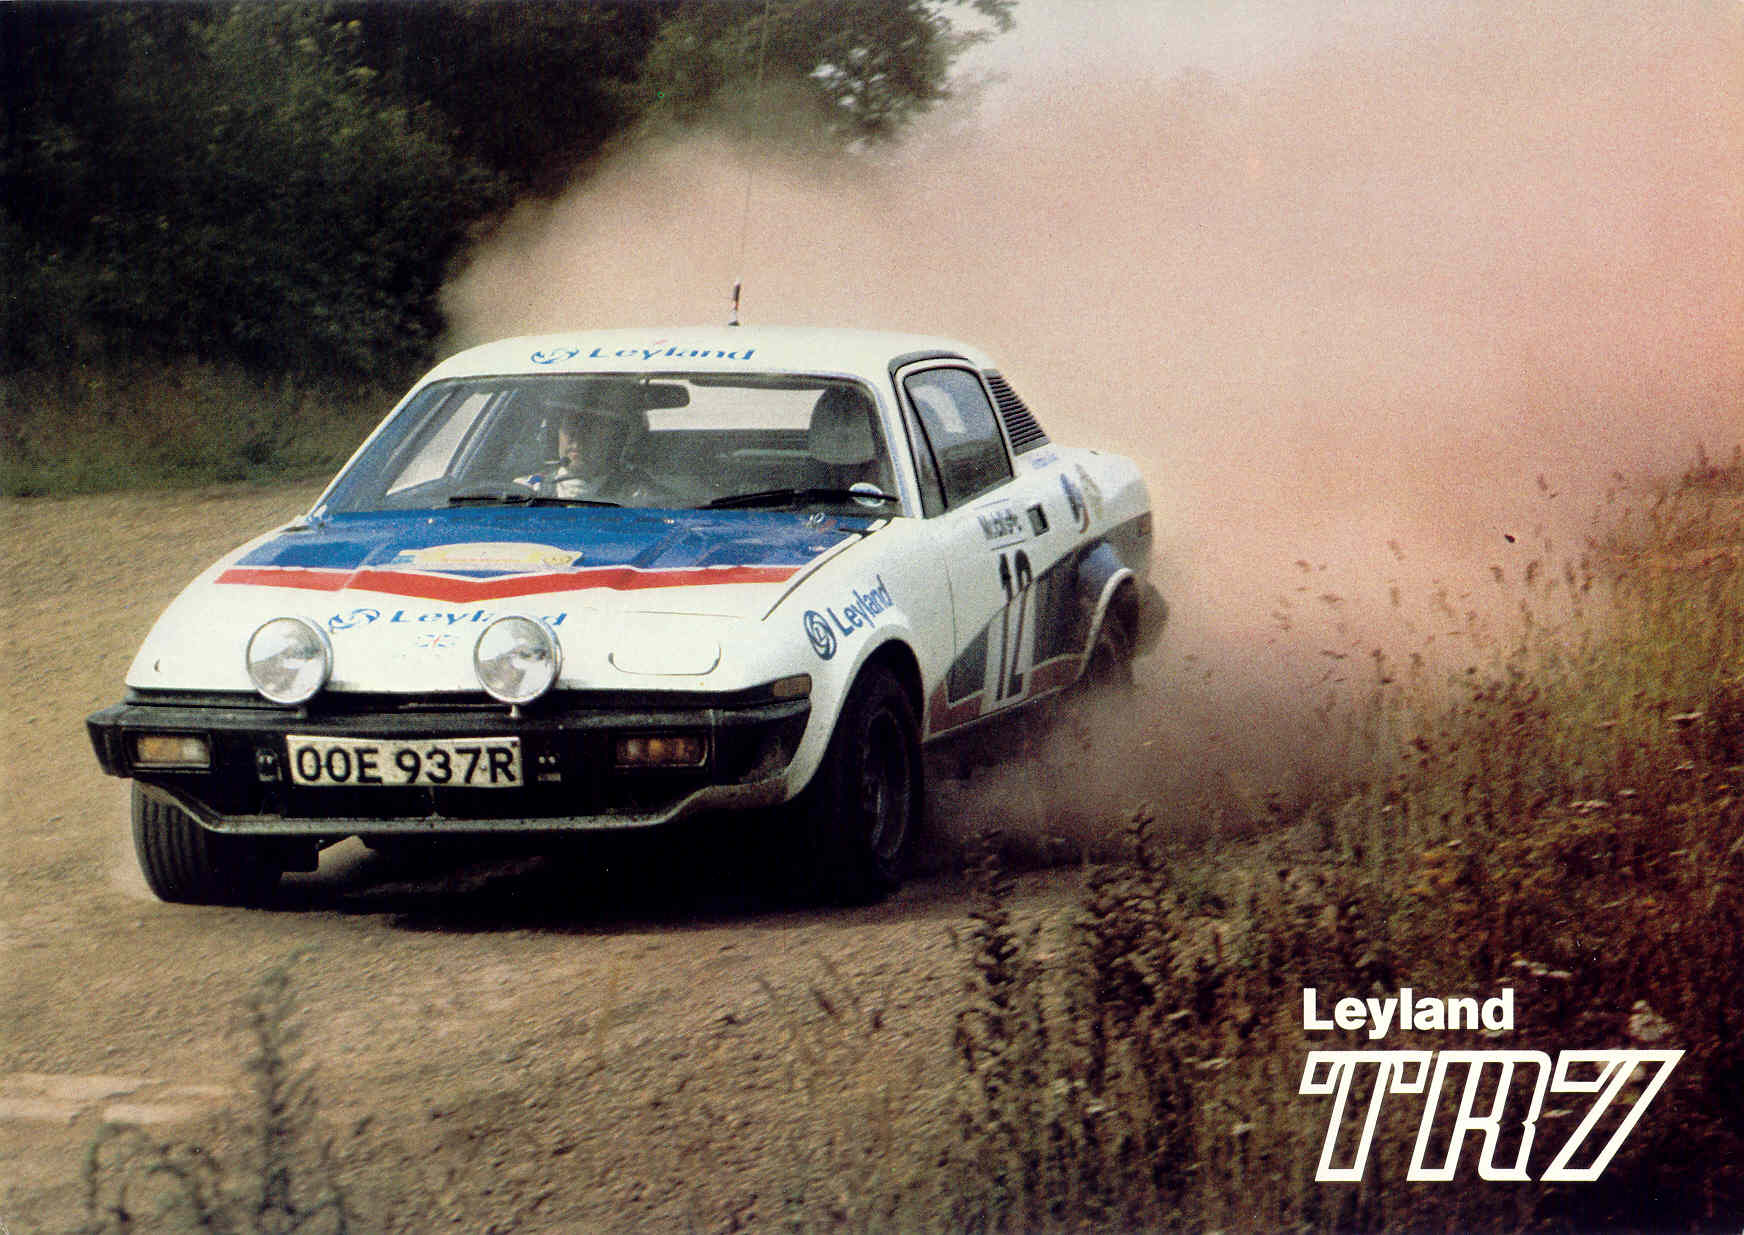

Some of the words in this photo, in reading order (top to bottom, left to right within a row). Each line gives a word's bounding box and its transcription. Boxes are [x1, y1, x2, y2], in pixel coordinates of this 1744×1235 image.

[587, 346, 756, 361] Leyland
[826, 573, 894, 637] Leyland
[296, 746, 382, 783] OOE
[395, 747, 516, 784] 937R
